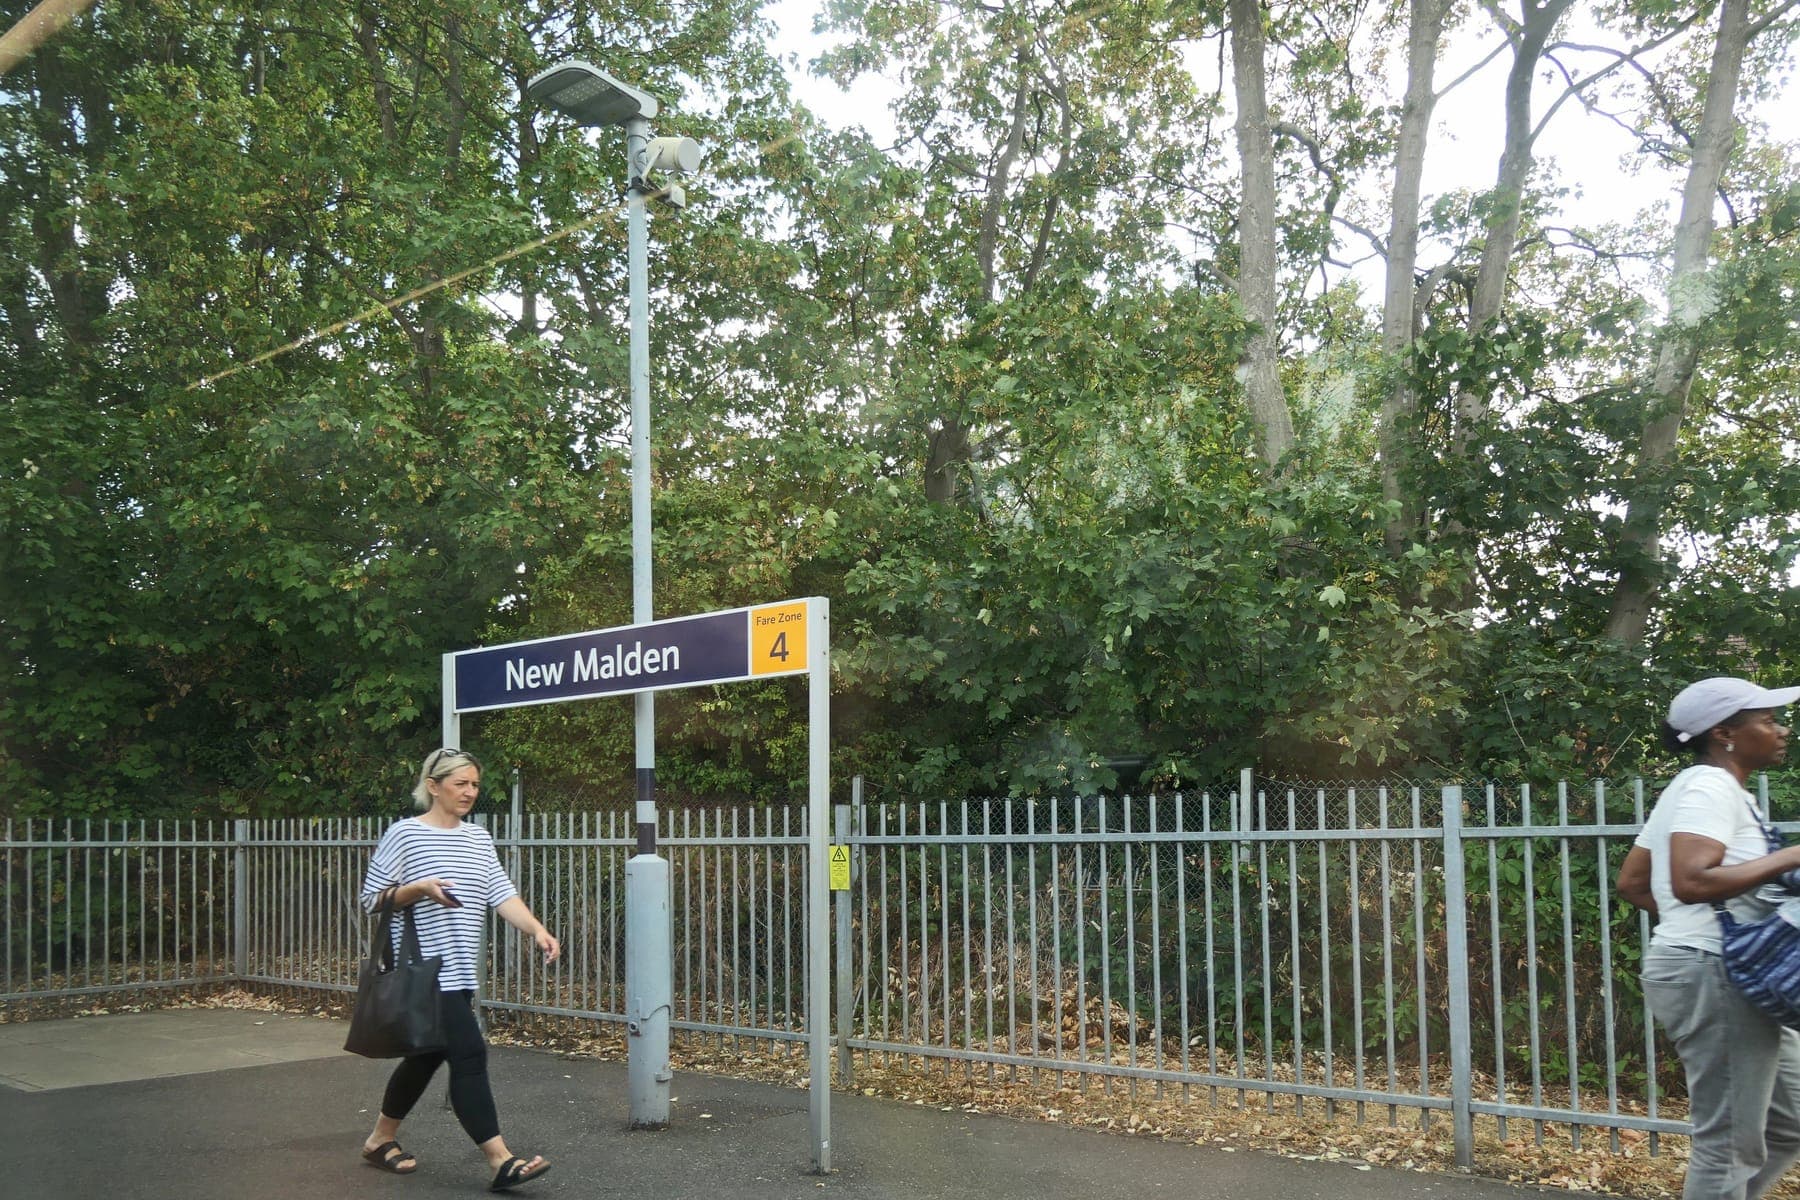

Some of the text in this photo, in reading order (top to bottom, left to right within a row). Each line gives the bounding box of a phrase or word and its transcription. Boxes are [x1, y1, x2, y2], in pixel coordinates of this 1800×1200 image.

[756, 612, 802, 626] Fare Zone
[769, 631, 790, 662] 4
[505, 641, 680, 692] New Malden
